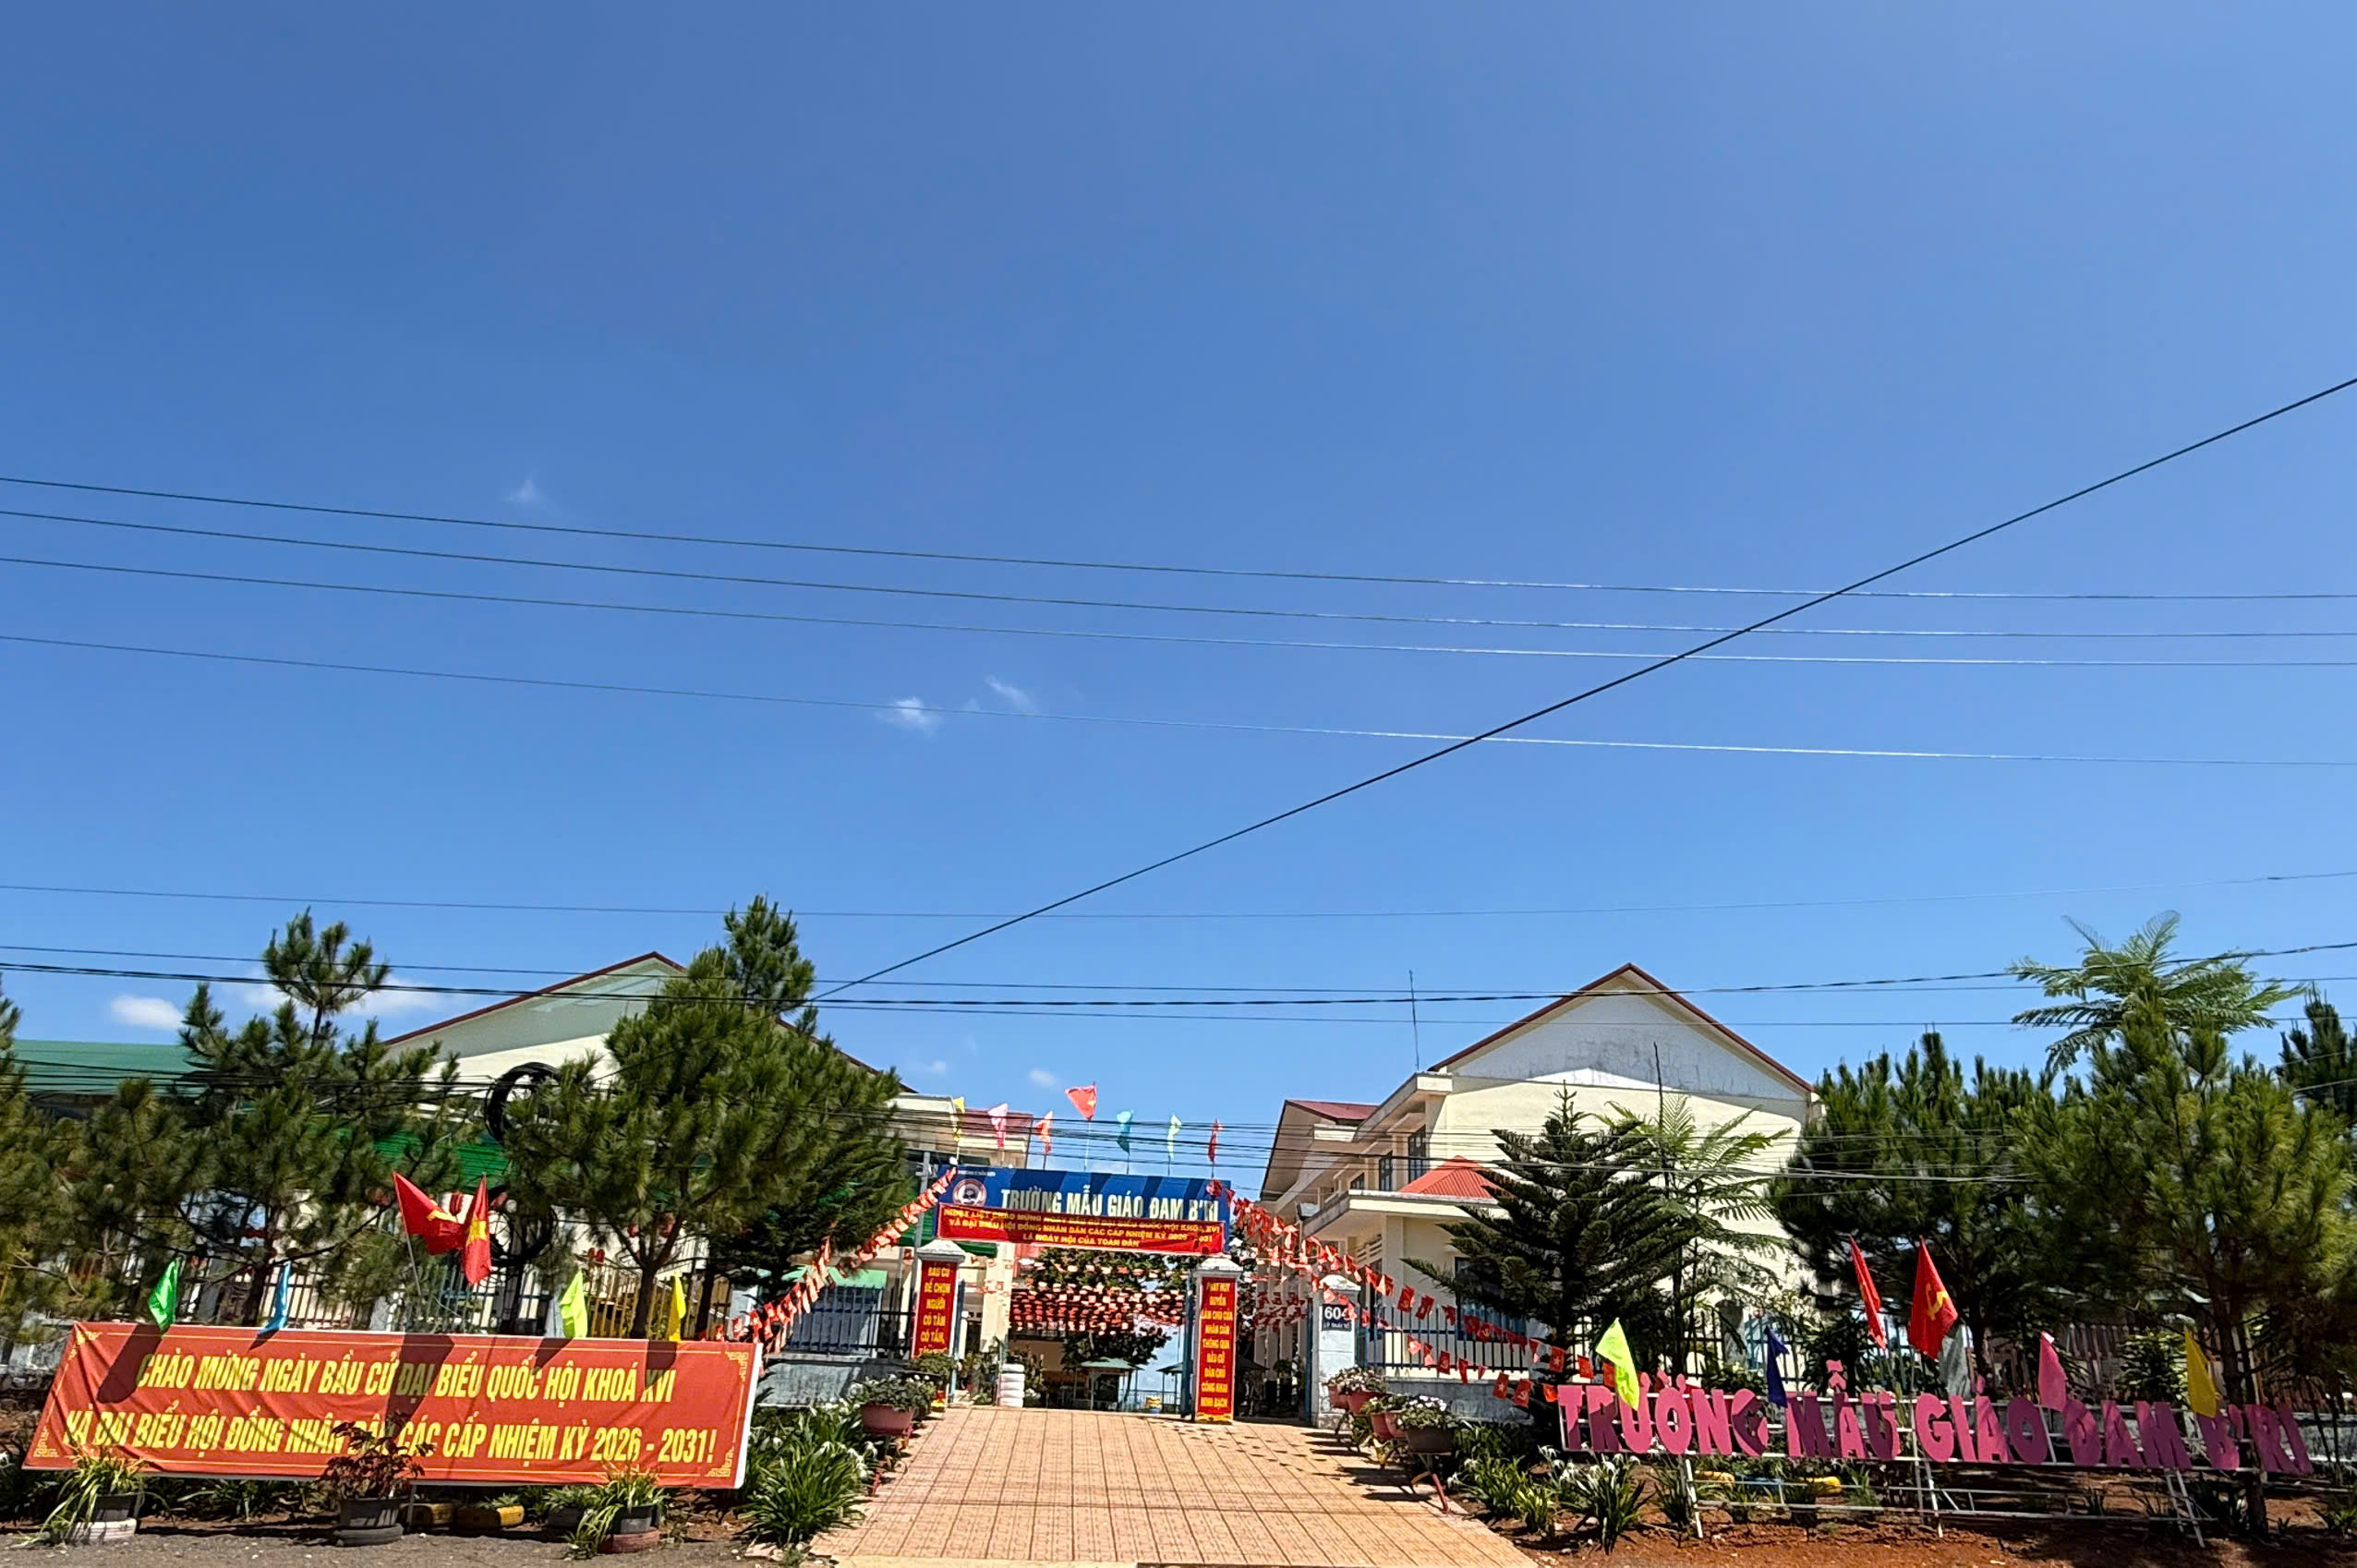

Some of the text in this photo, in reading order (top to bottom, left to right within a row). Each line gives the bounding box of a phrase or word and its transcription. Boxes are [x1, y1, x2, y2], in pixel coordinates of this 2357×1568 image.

[1001, 1186, 1062, 1214] TRƯỜNG
[1066, 1184, 1103, 1217] MẪU
[1107, 1190, 1143, 1219] GIÁO
[1149, 1197, 1184, 1220] ĐAM
[1035, 1233, 1059, 1242] NGÀY
[1061, 1235, 1077, 1245] HỘI
[1078, 1235, 1095, 1244] CỦA
[1121, 1238, 1140, 1248] DÂN
[1043, 1224, 1067, 1233] NHÂN
[1069, 1224, 1086, 1235] DÂN
[1088, 1226, 1106, 1236] CÁC
[136, 1347, 677, 1408] CHÀO MỪNG NGÀY BẦU CỬ ĐẠI BIỂU QUỐC HỘI KHOÁ XVI
[62, 1403, 93, 1446] VÀ
[92, 1410, 136, 1453] ĐẠI
[132, 1399, 187, 1449] BIỂU
[184, 1407, 225, 1458] HỘI
[224, 1405, 285, 1453] ĐỒNG
[285, 1412, 347, 1454] NHÂN
[397, 1414, 441, 1458] CÁC
[442, 1411, 488, 1459] CẤP
[488, 1418, 558, 1466] NHIỆM
[559, 1418, 590, 1461] KỲ
[589, 1427, 643, 1463] 2026
[658, 1428, 718, 1464] 2031!
[1557, 1368, 1769, 1456] TRƯỜNG
[1786, 1359, 1902, 1461] MẪU
[1916, 1374, 2048, 1465] GIÁO
